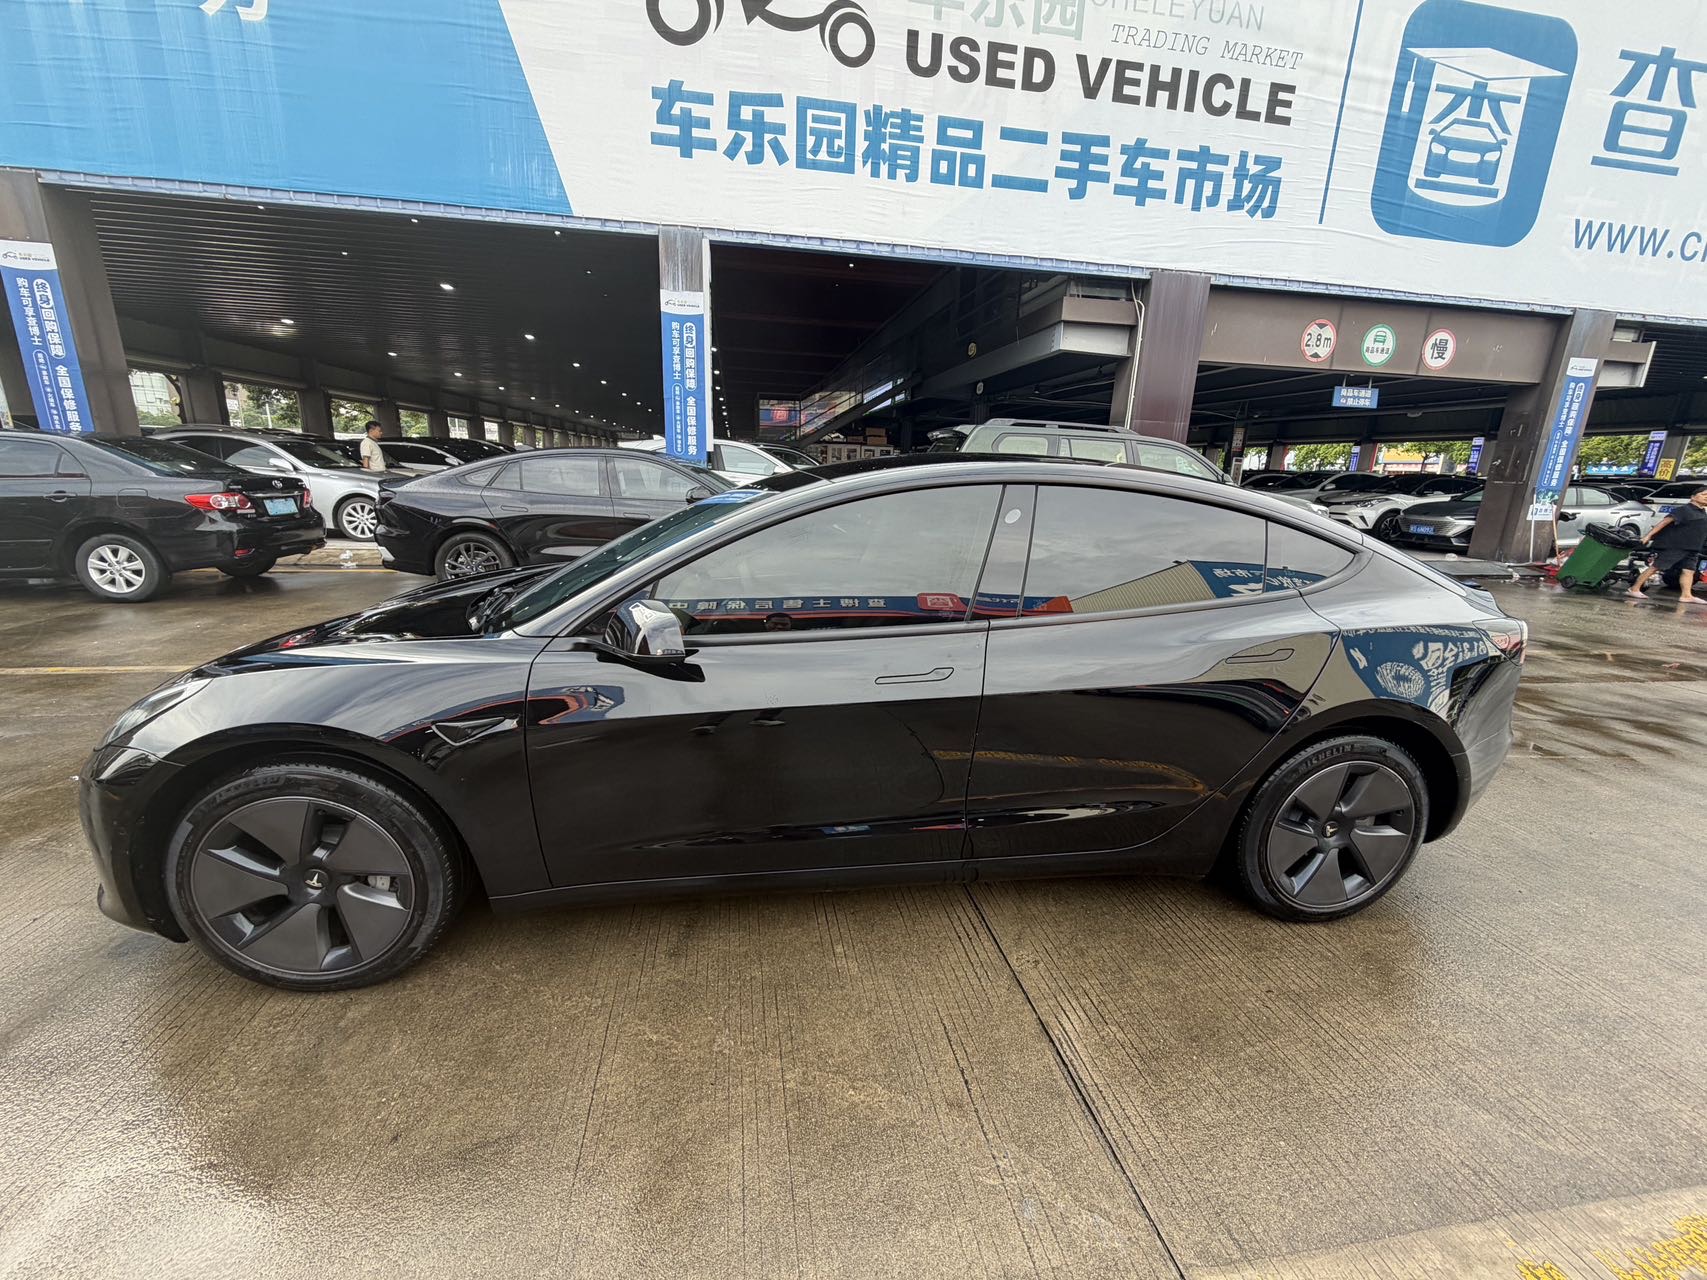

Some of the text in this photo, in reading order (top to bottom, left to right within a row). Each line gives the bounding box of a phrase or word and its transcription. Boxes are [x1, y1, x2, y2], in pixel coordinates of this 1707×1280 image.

[1092, 0, 1264, 31] ELEYUAN
[1111, 24, 1304, 70] TRADING MARKET
[906, 29, 1297, 127] USED VEHICLE
[1589, 46, 1707, 176] 查
[650, 79, 1283, 219] 车乐园精品二手车市场
[16, 277, 42, 345] 购车可享查博士
[1305, 332, 1332, 349] 2.8m
[35, 281, 63, 357] 终身回购保障
[55, 365, 82, 433] 全国保修服务
[672, 321, 682, 380] 购车可享查博士
[1431, 338, 1449, 360] 慢
[684, 324, 698, 456] 终身回购保障 全国保修服务
